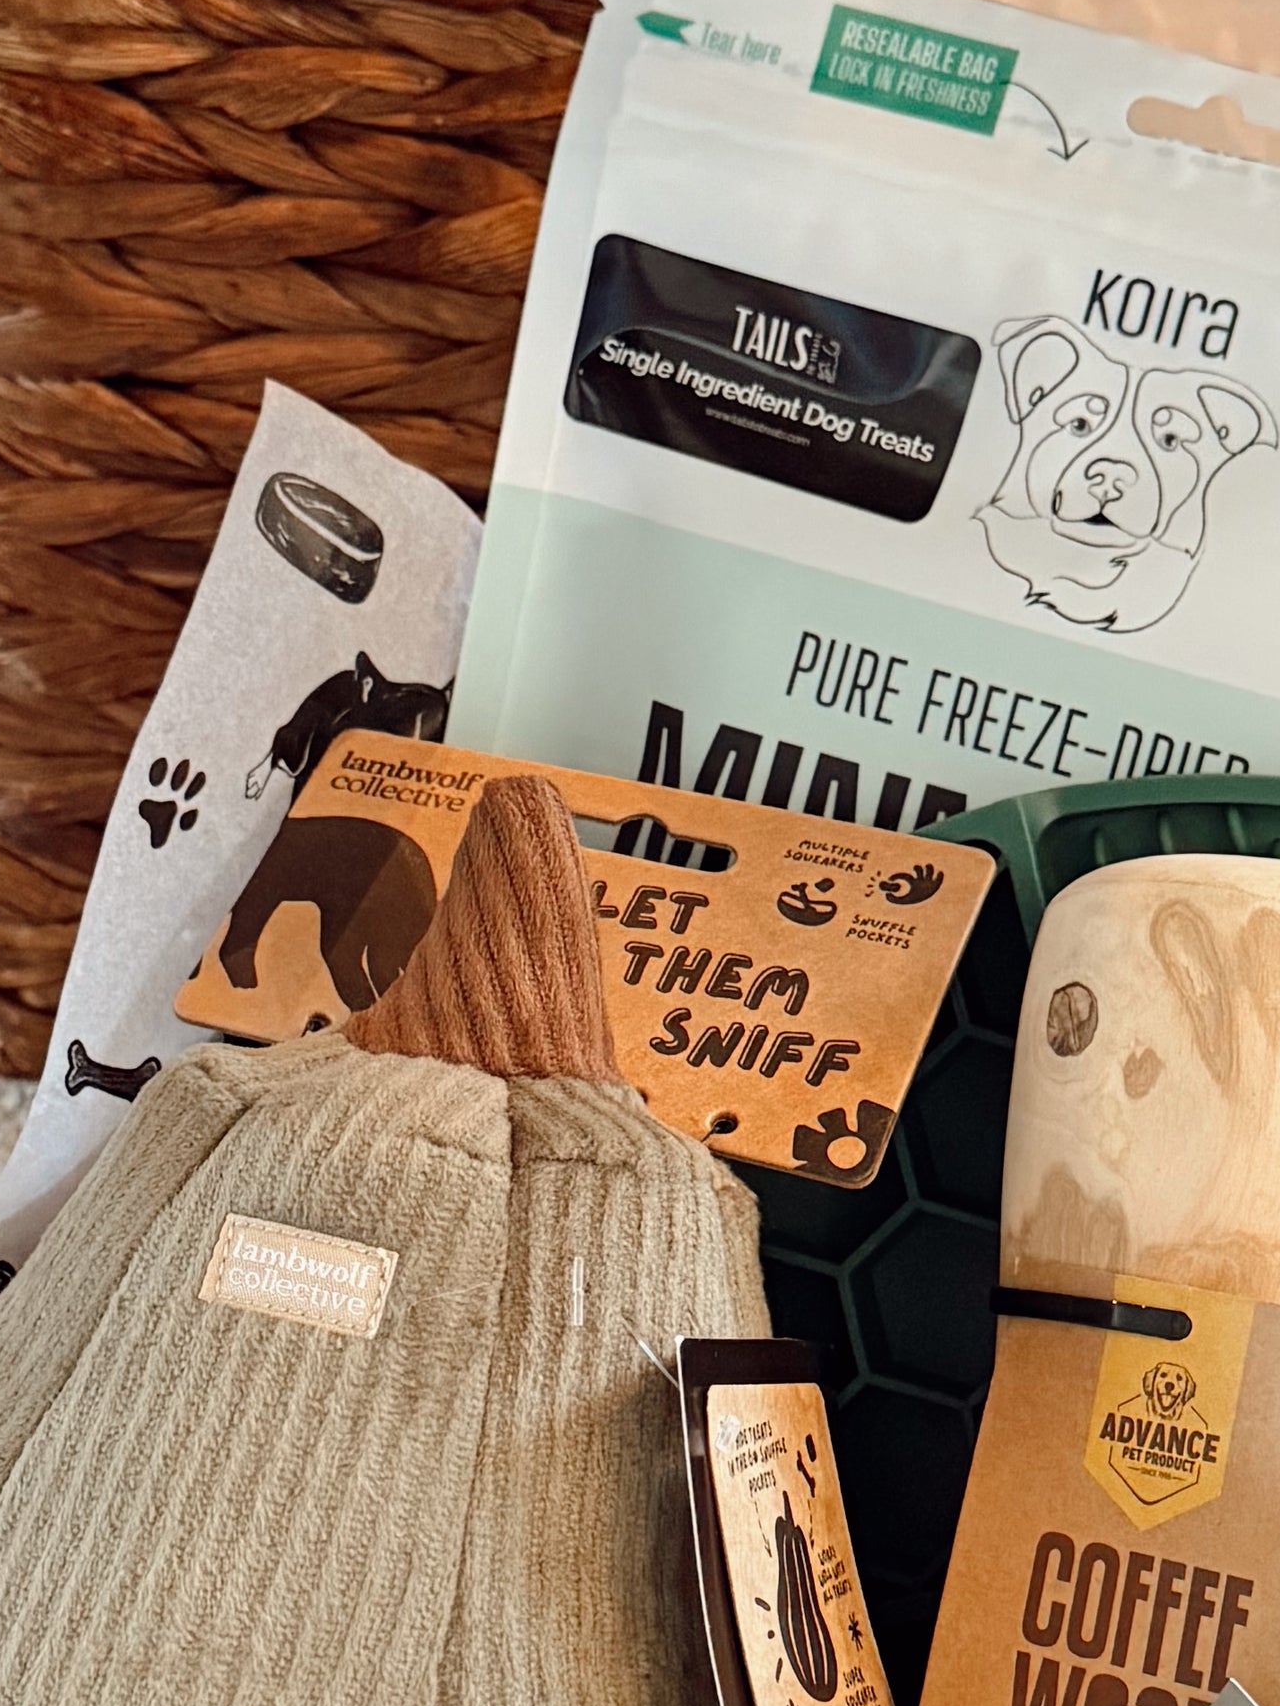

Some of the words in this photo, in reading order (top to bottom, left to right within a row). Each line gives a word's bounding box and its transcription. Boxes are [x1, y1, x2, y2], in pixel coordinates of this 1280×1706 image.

[699, 22, 734, 56] Tear
[740, 31, 782, 66] here
[841, 20, 957, 73] RESEALABLE
[958, 50, 999, 85] BAG
[828, 53, 875, 88] LOCK
[873, 62, 897, 93] IN
[896, 67, 992, 116] FRESHNESS
[732, 305, 813, 371] TAILS
[600, 338, 675, 379] Single
[674, 360, 801, 421] Ingredient
[802, 402, 856, 442] Dog
[859, 417, 934, 463] Treats
[786, 630, 909, 726] PURE
[330, 774, 466, 813] collective
[341, 750, 484, 792] lambwolf
[784, 849, 865, 874] SQUEAKERS
[798, 840, 871, 861] MULTIPLE
[591, 880, 709, 935] LET
[852, 914, 917, 936] SNUFFLE
[845, 928, 910, 950] POCKETS
[624, 940, 810, 1016] THEM
[649, 1007, 861, 1087] SNIFF
[232, 1234, 379, 1290] lambwolf
[228, 1267, 367, 1316] collective
[1099, 1412, 1220, 1464] ADVANCE
[1122, 1446, 1142, 1461] PET
[1144, 1451, 1195, 1473] PRODUCT
[1022, 1531, 1254, 1694] COFFEE
